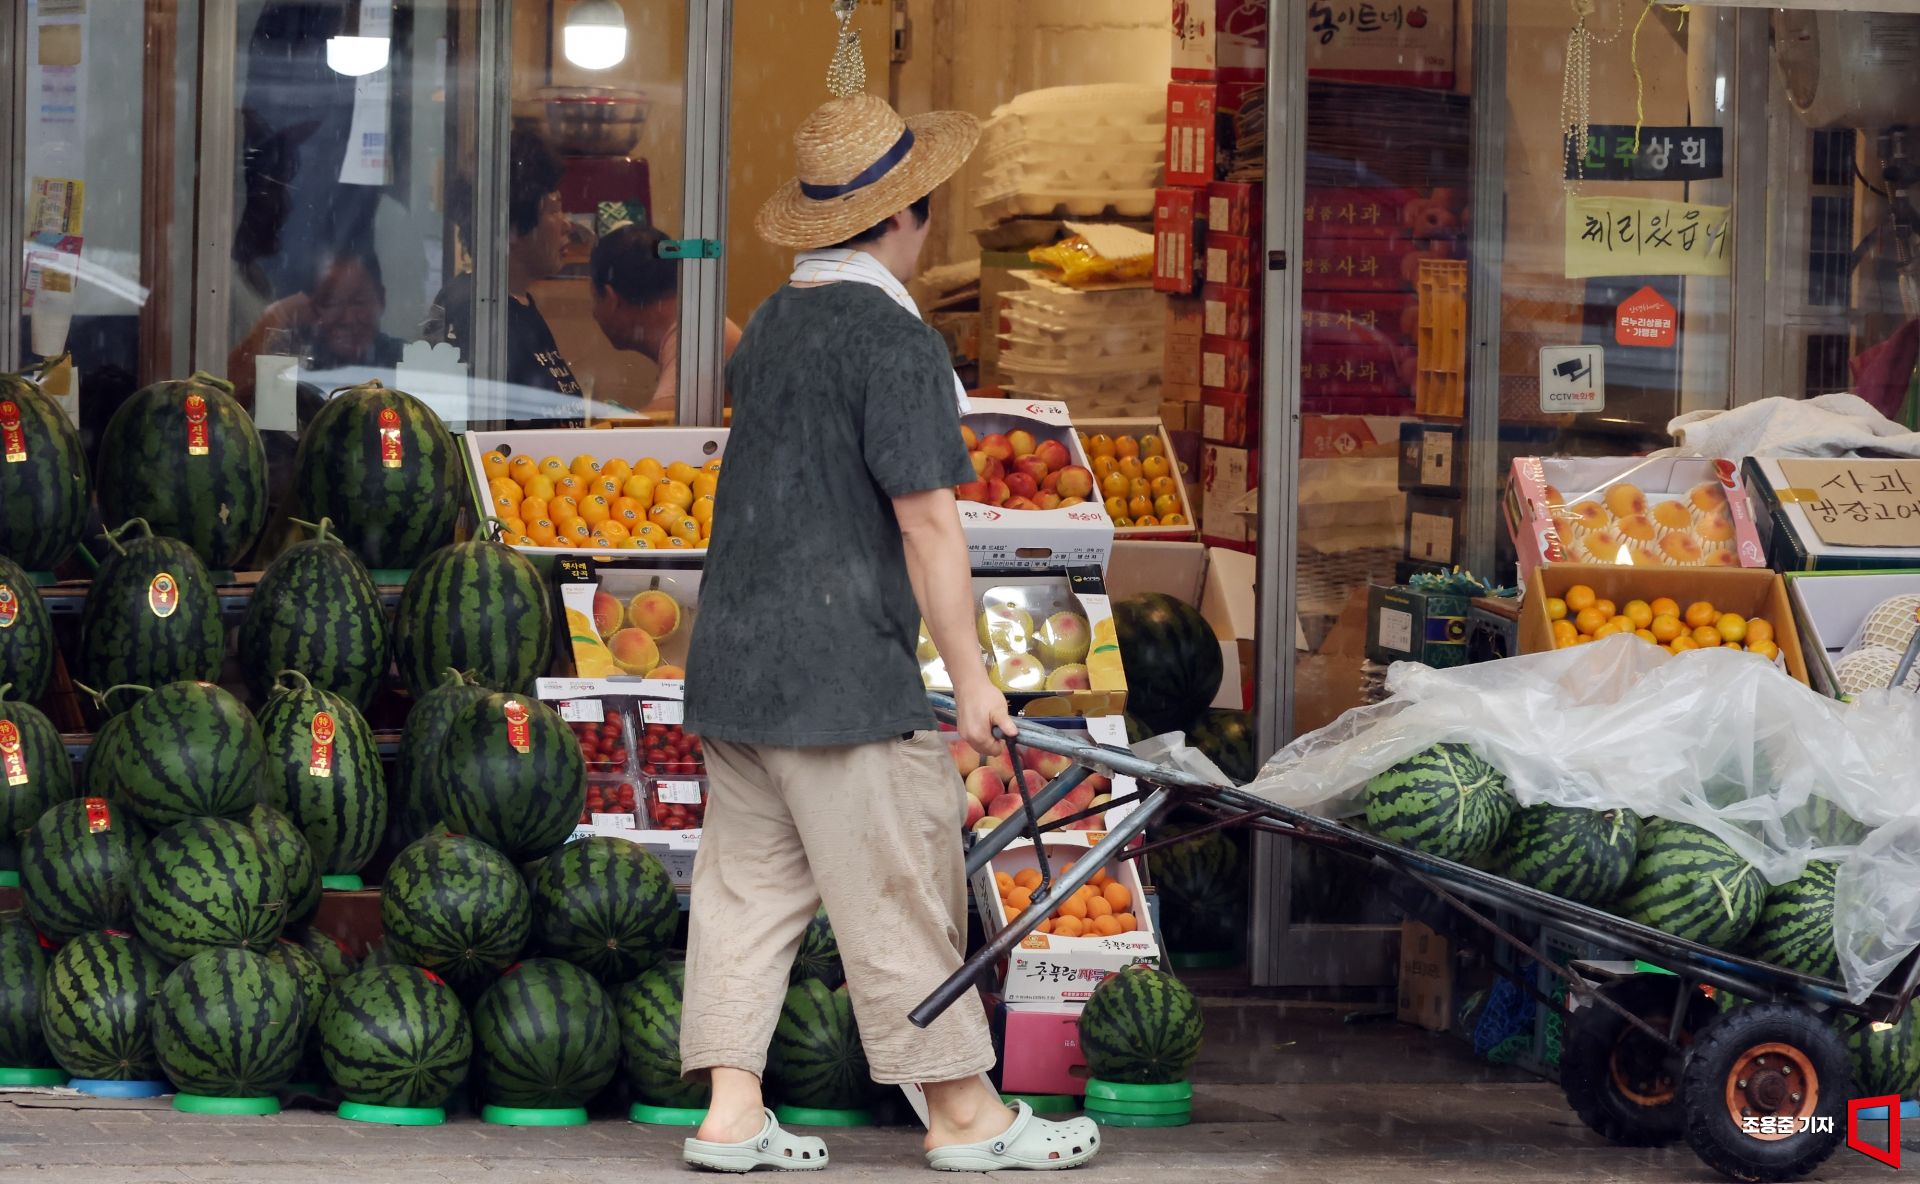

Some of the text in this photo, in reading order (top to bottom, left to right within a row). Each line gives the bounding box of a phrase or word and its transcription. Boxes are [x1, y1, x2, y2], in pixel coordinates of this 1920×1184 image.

[1621, 317, 1671, 328] 온누리상품권
[1633, 328, 1659, 337] 가맹점
[1820, 468, 1913, 495] 사과
[1067, 512, 1102, 521] 복숭아
